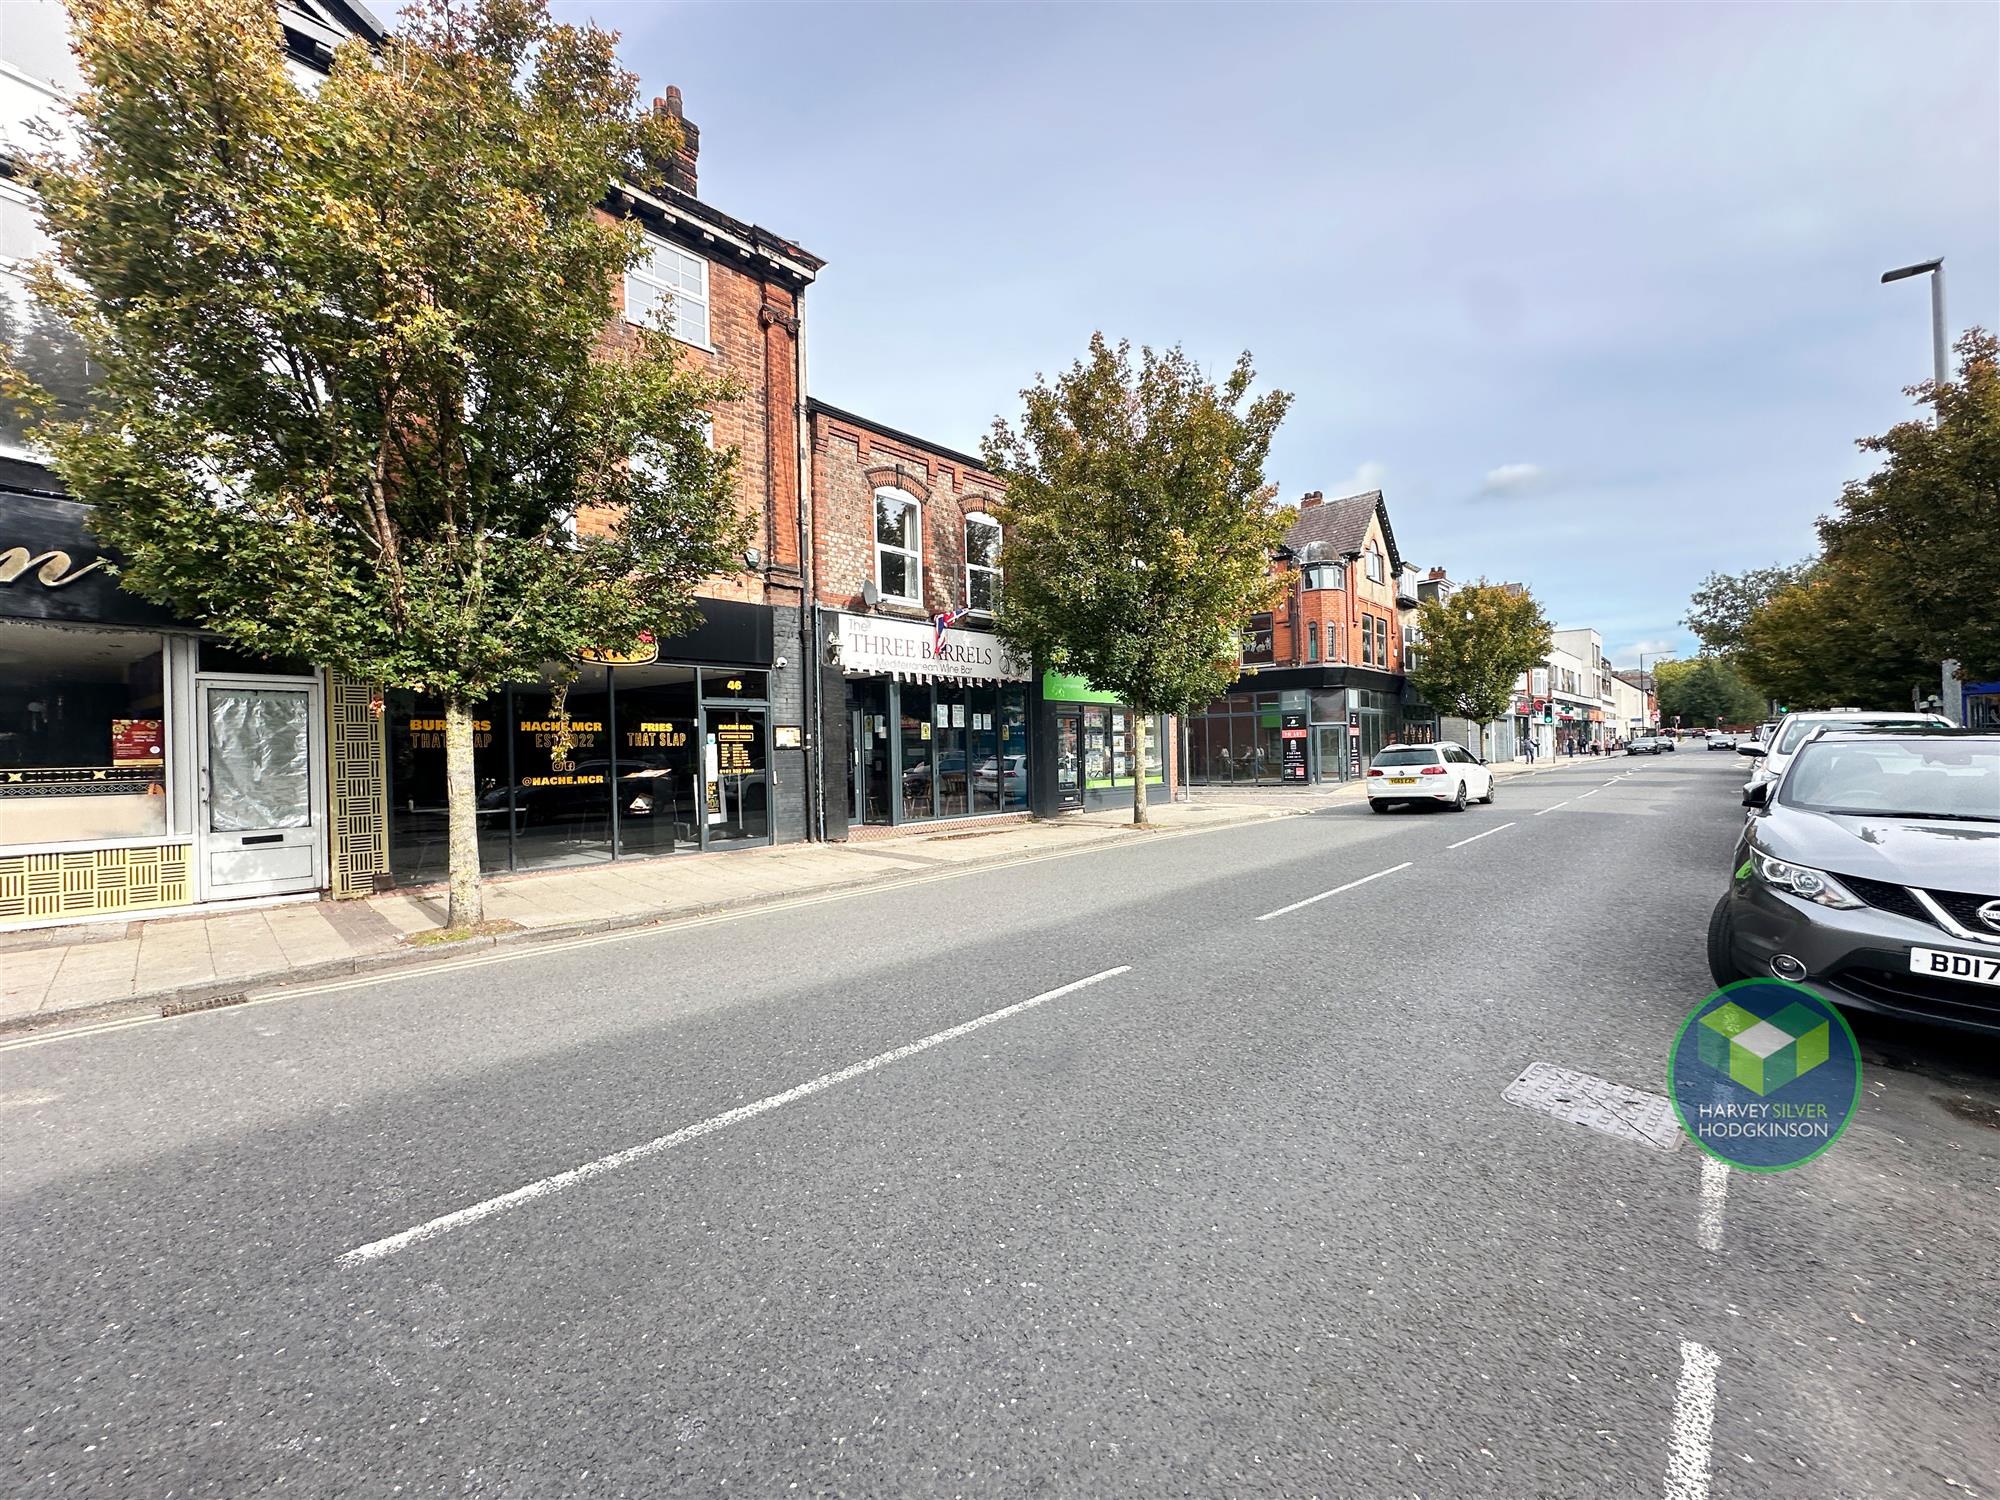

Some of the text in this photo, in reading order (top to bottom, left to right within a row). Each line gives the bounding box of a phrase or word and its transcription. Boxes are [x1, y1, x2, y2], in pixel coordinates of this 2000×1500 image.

[848, 618, 868, 631] The
[848, 632, 992, 665] THREE BARRELS
[940, 663, 959, 673] Wine
[960, 665, 973, 674] Bar
[727, 680, 742, 690] 46
[409, 719, 492, 731] BURRS
[640, 722, 673, 732] FRIES
[562, 733, 595, 748] 022
[627, 732, 687, 747] THAT SLAP
[521, 775, 604, 786] @HACHE.MCR
[1930, 953, 2000, 980] BD17
